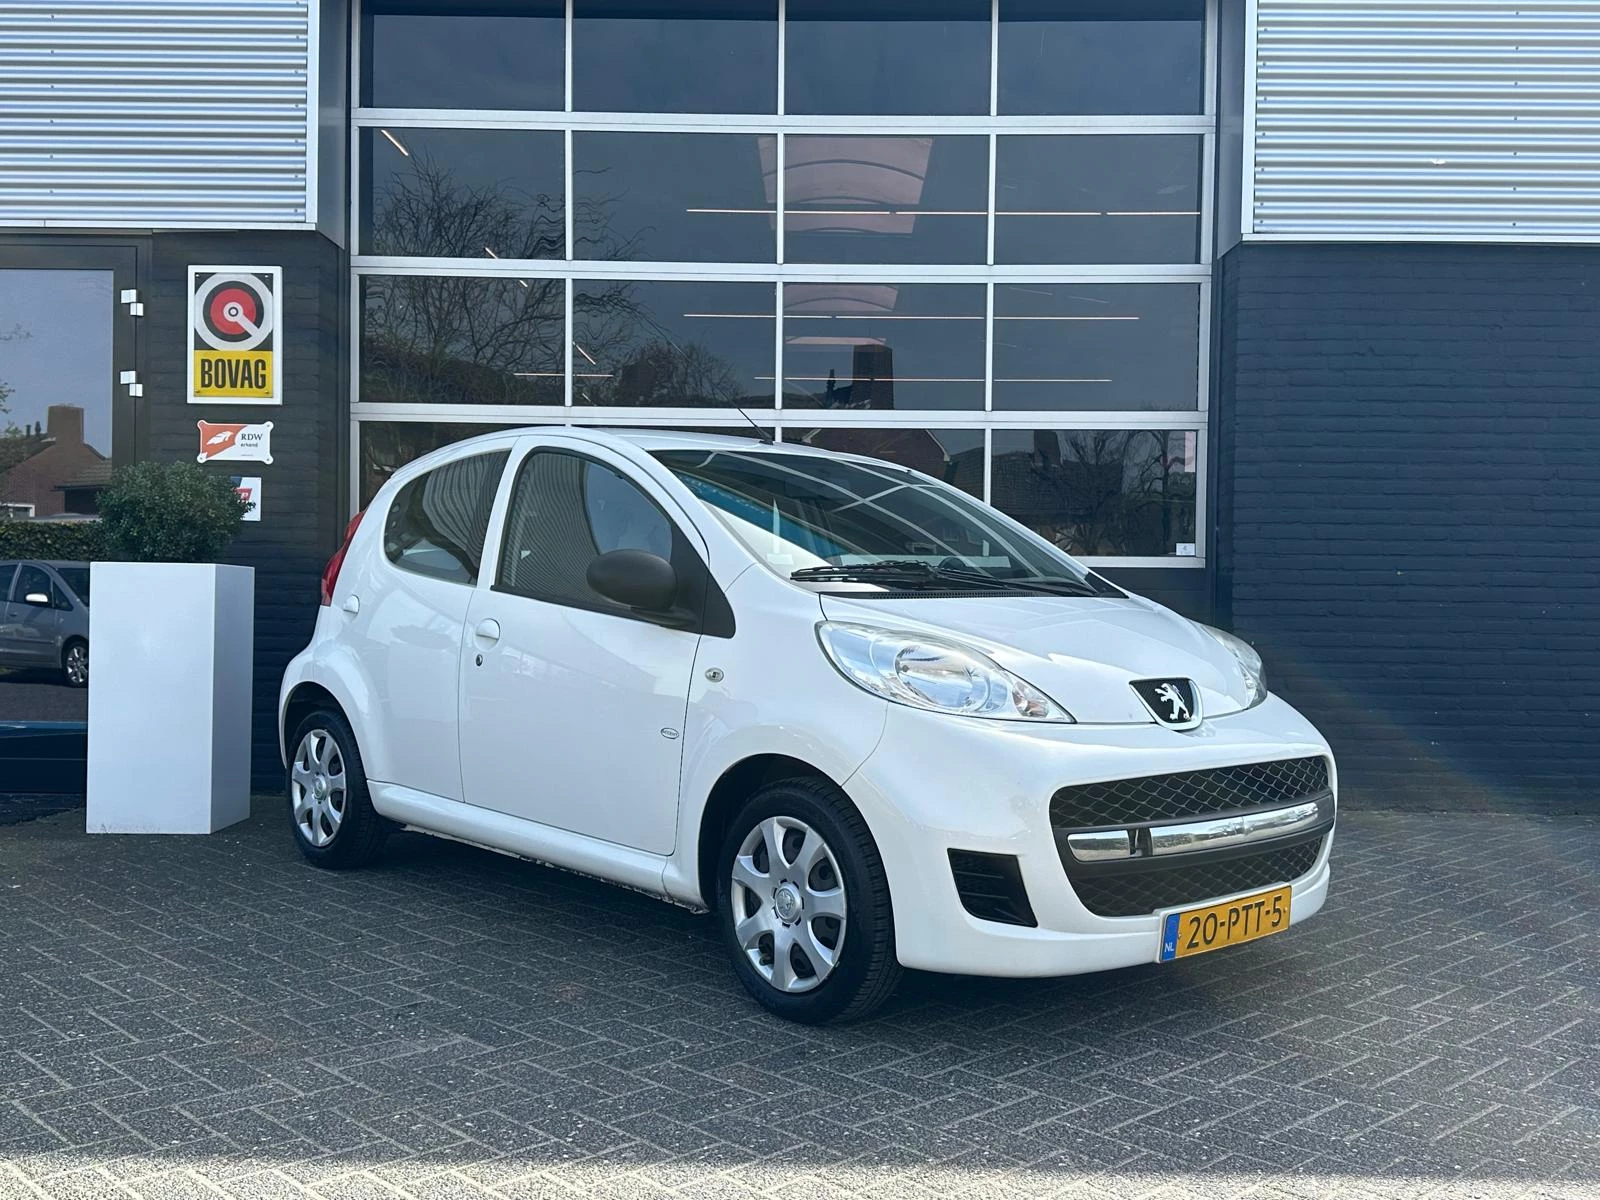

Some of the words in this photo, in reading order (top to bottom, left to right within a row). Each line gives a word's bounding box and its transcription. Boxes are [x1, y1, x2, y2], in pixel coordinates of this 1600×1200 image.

[201, 358, 266, 389] BOVAG
[241, 433, 263, 441] RDW
[1164, 942, 1175, 953] NL
[1186, 895, 1282, 949] 20-PTT-5
